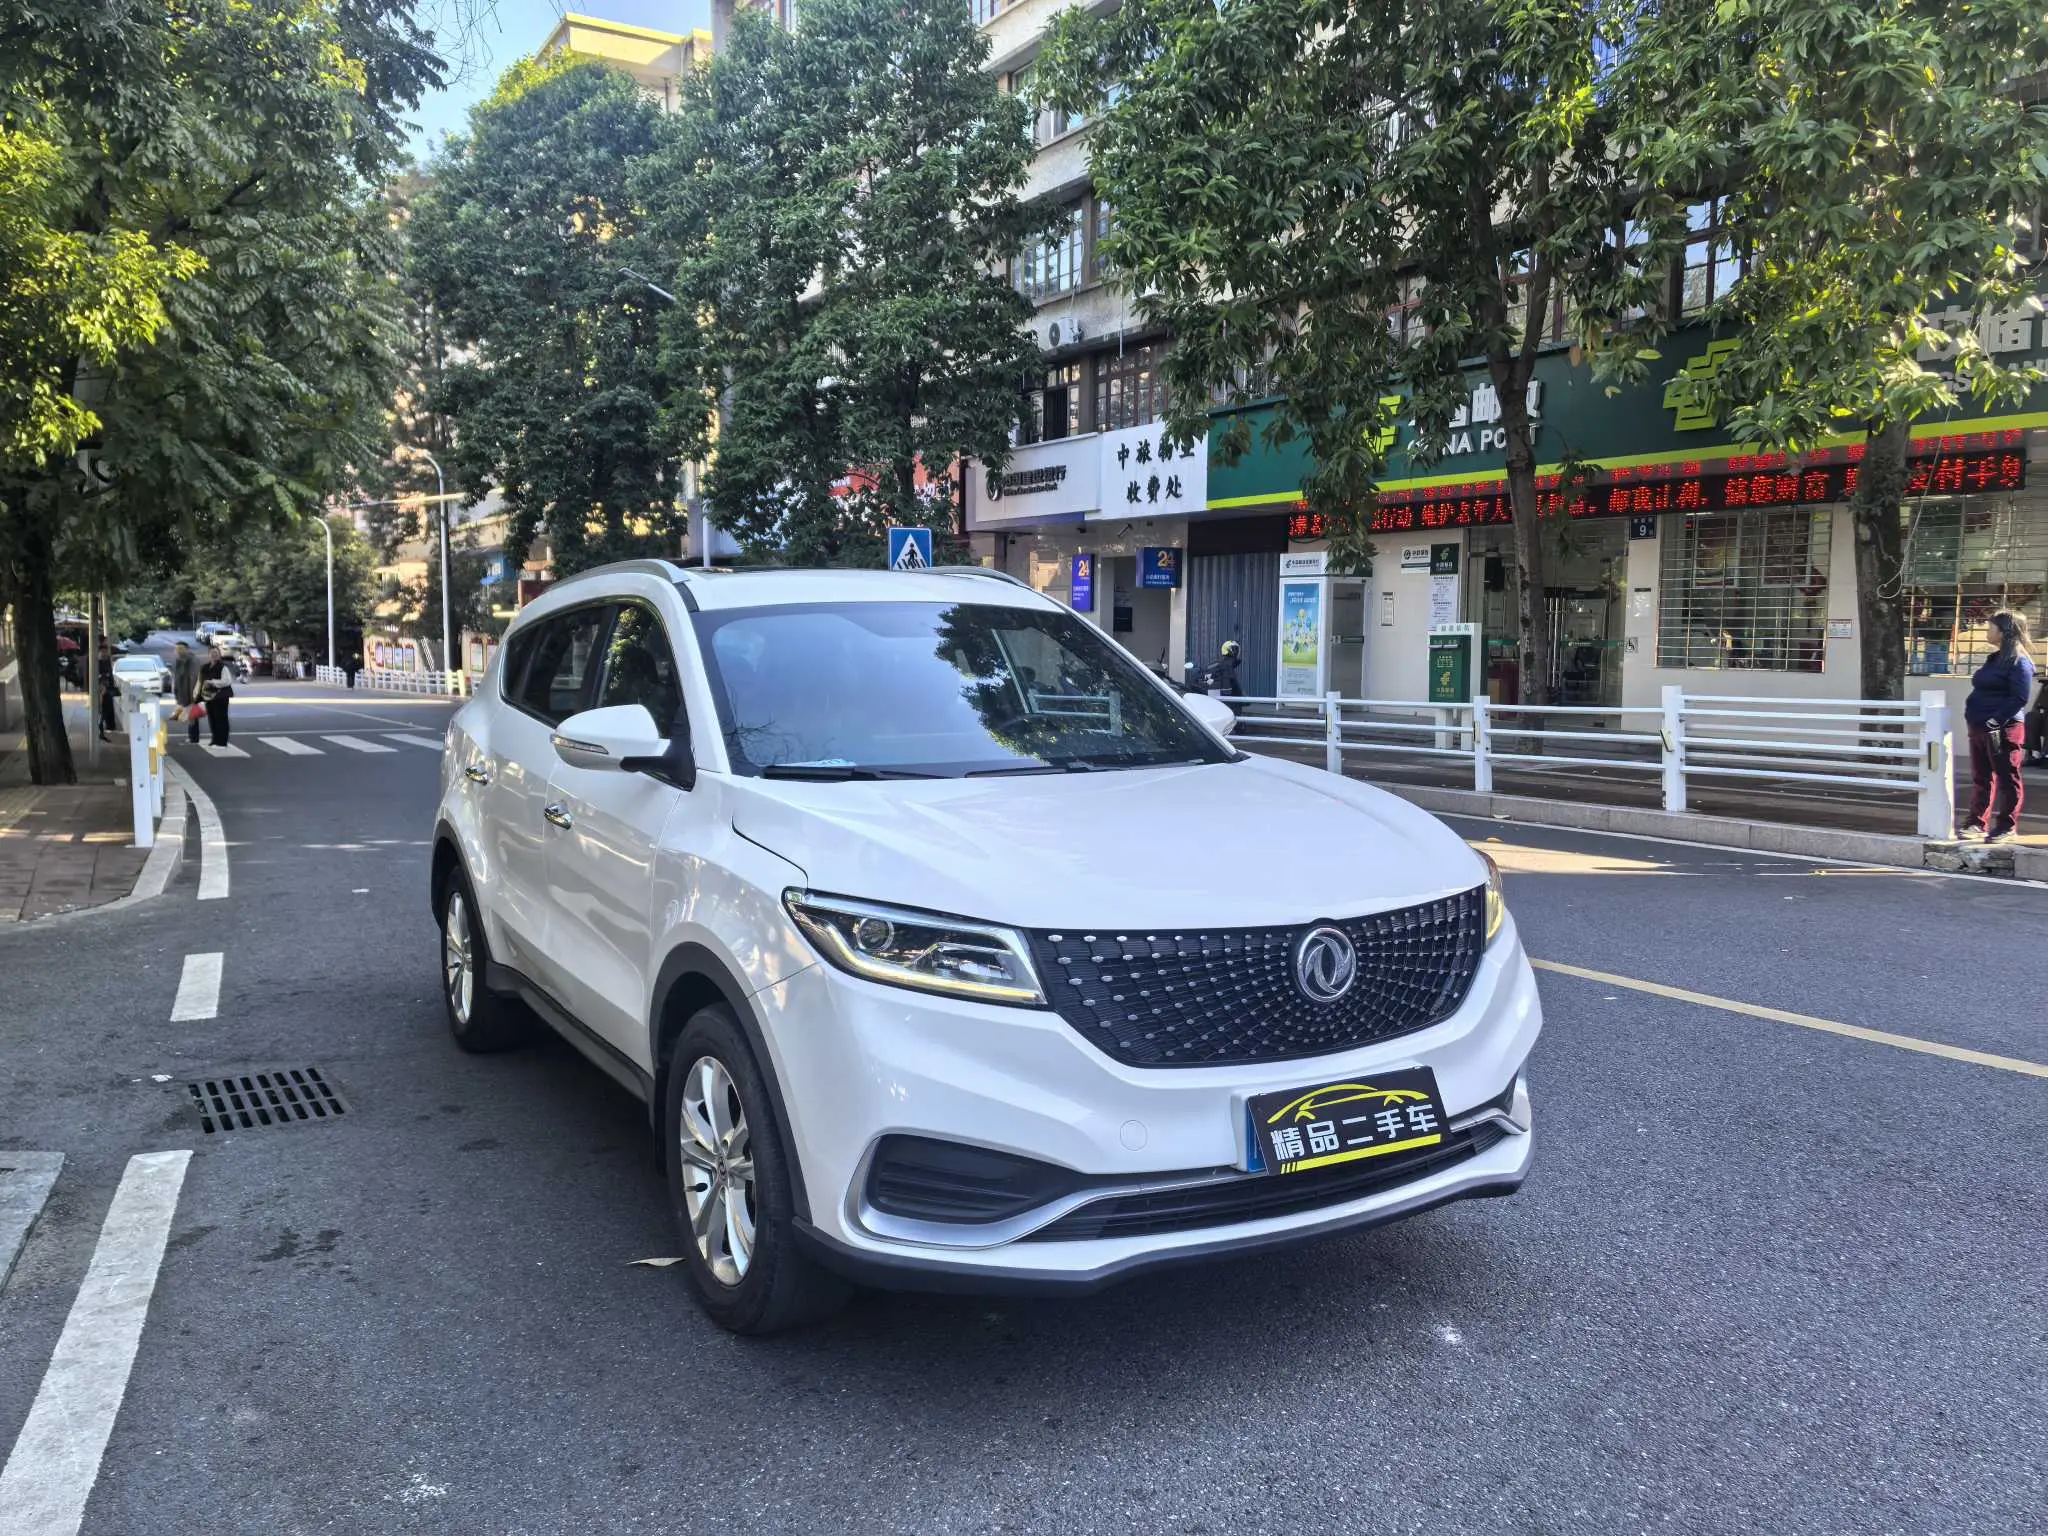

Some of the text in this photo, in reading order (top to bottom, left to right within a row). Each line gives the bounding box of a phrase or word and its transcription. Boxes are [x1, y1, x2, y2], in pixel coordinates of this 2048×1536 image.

[1480, 424, 1538, 451] POT
[1126, 474, 1183, 504] 收费处
[1270, 1103, 1438, 1161] 精品二手车
